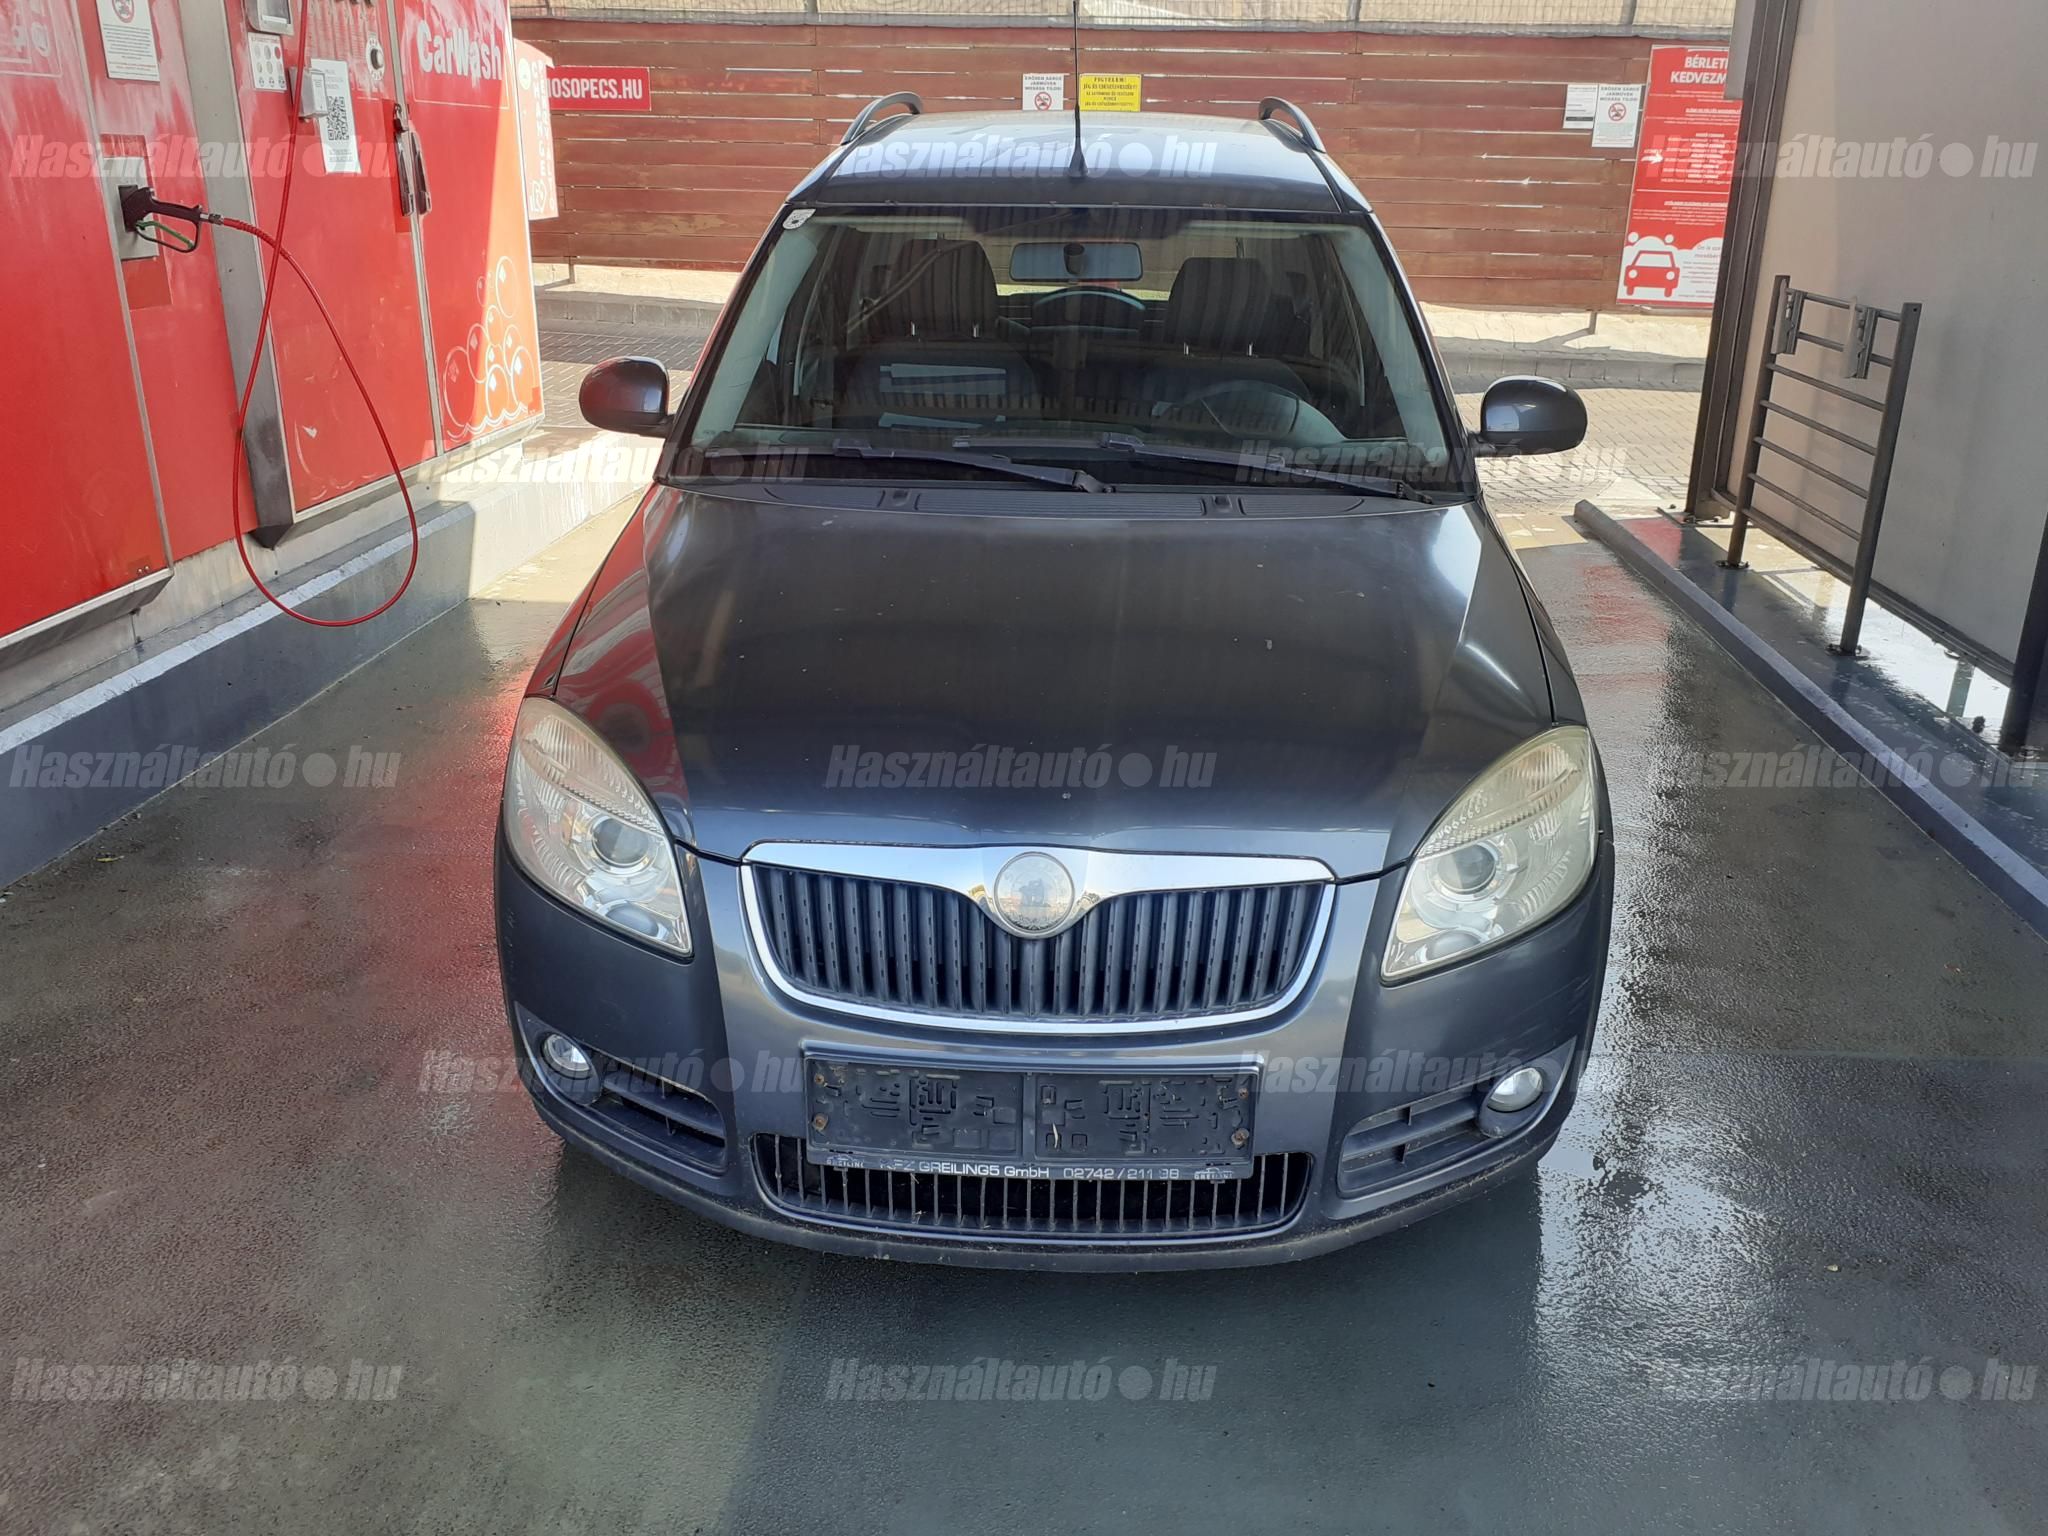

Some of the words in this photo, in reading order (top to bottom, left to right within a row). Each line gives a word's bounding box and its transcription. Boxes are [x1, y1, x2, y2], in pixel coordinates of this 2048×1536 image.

[417, 20, 502, 80] CarWash
[548, 78, 643, 99] OSOPECS.HU
[1004, 1165, 1050, 1179] GmbH
